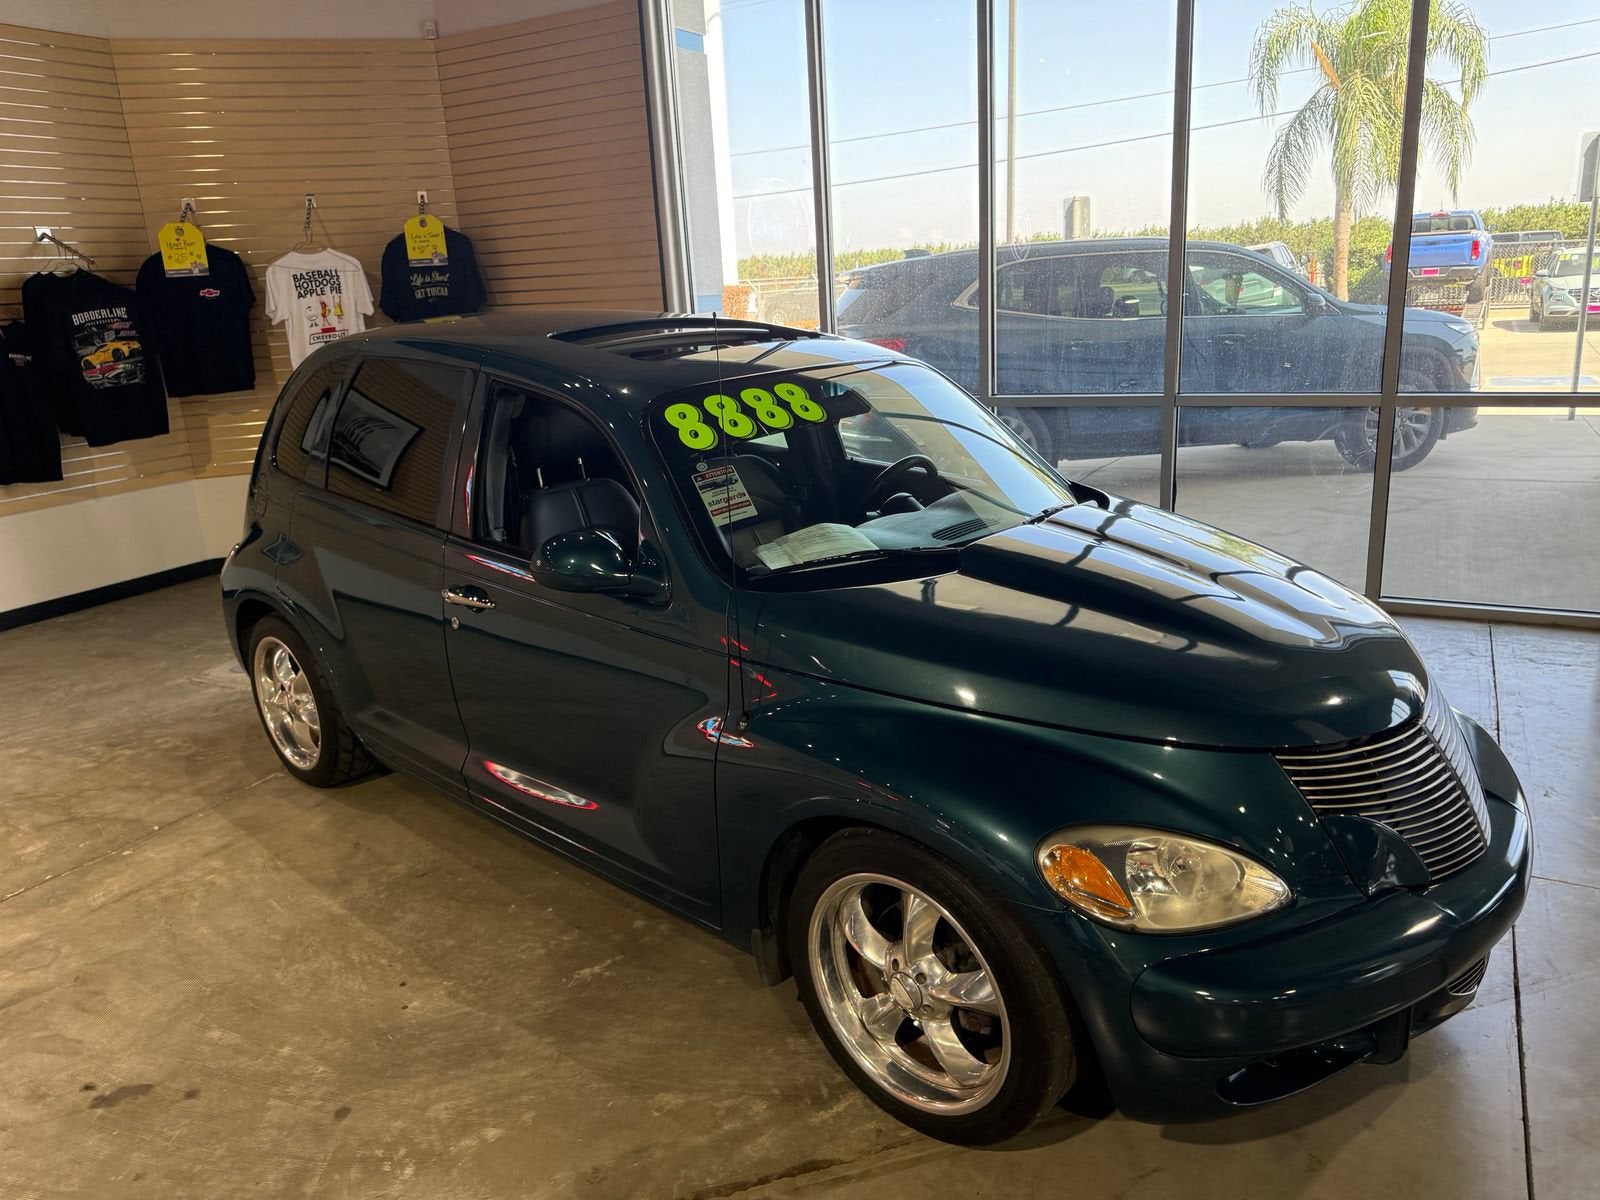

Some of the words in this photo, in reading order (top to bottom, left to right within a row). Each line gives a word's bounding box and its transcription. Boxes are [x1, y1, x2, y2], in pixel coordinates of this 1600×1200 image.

[292, 268, 340, 283] BASEBALL
[294, 277, 342, 292] HOTDOGS
[297, 286, 327, 300] APPLE
[329, 285, 343, 295] PIE
[71, 307, 128, 326] BORDERLINE
[312, 331, 347, 342] CHEVROLET
[664, 383, 827, 451] 8888
